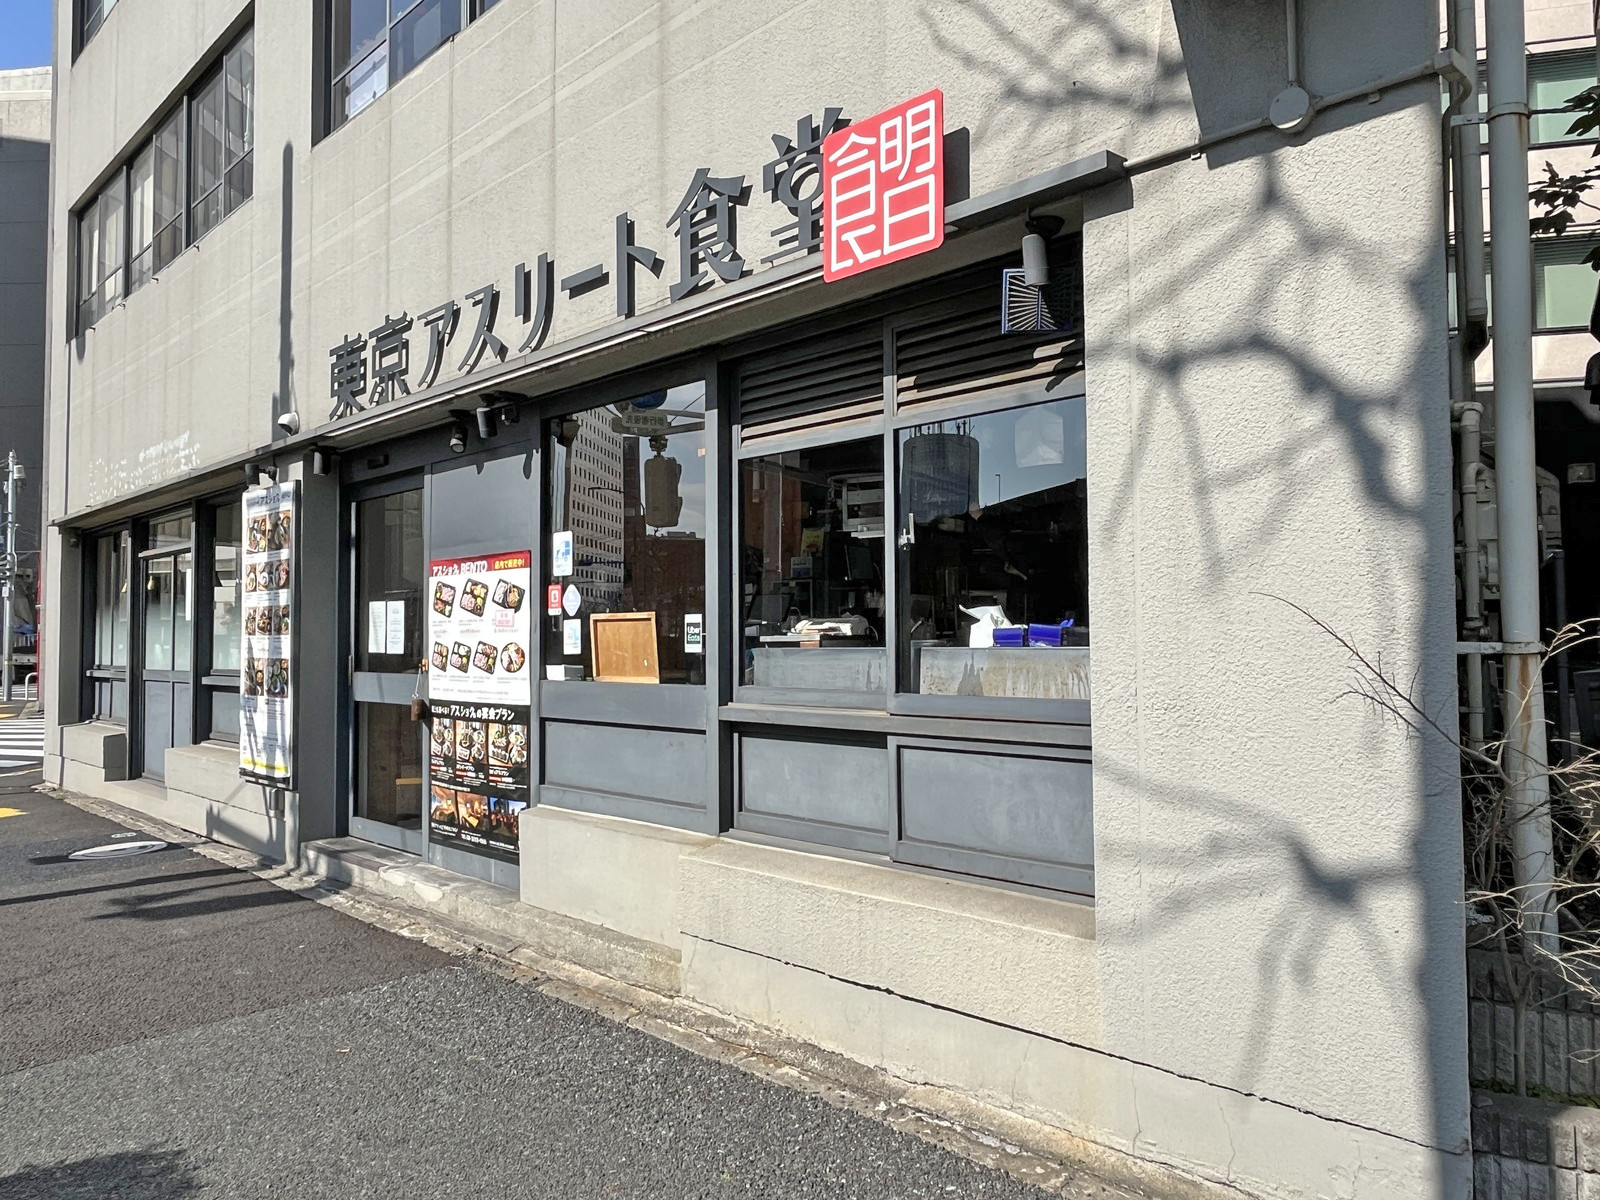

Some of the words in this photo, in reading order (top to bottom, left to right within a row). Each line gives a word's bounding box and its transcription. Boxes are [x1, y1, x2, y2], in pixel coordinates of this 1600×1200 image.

[329, 107, 845, 421] 東京アスリート食堂
[460, 560, 488, 575] BENTO
[687, 625, 701, 634] Uber
[687, 633, 701, 642] Eats
